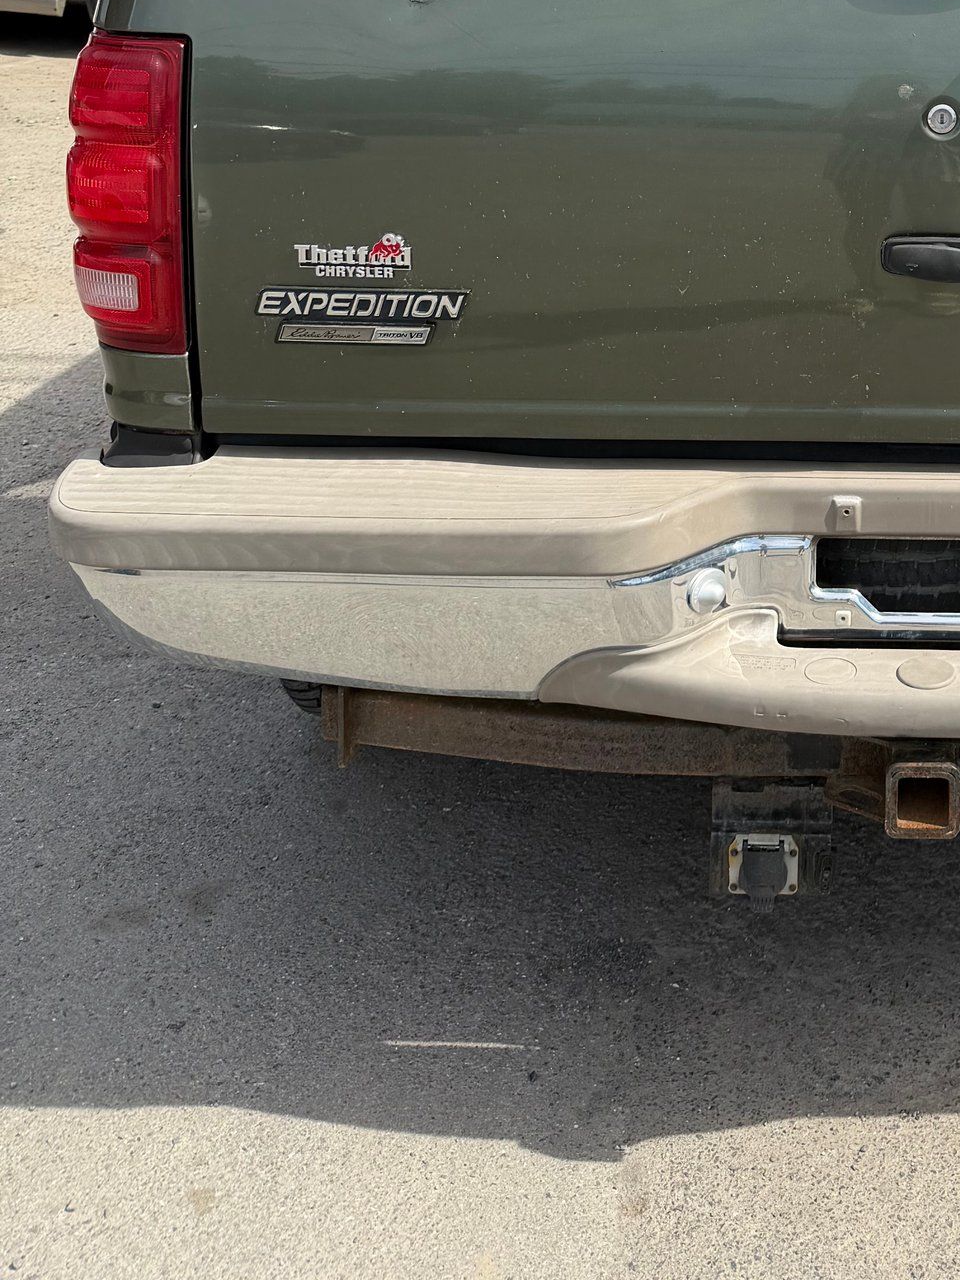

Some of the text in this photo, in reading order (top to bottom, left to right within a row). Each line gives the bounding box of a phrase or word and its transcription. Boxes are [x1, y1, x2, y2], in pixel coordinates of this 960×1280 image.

[315, 265, 394, 279] CHRYSLER
[257, 291, 465, 319] EXPEDITION
[409, 332, 424, 340] V8
